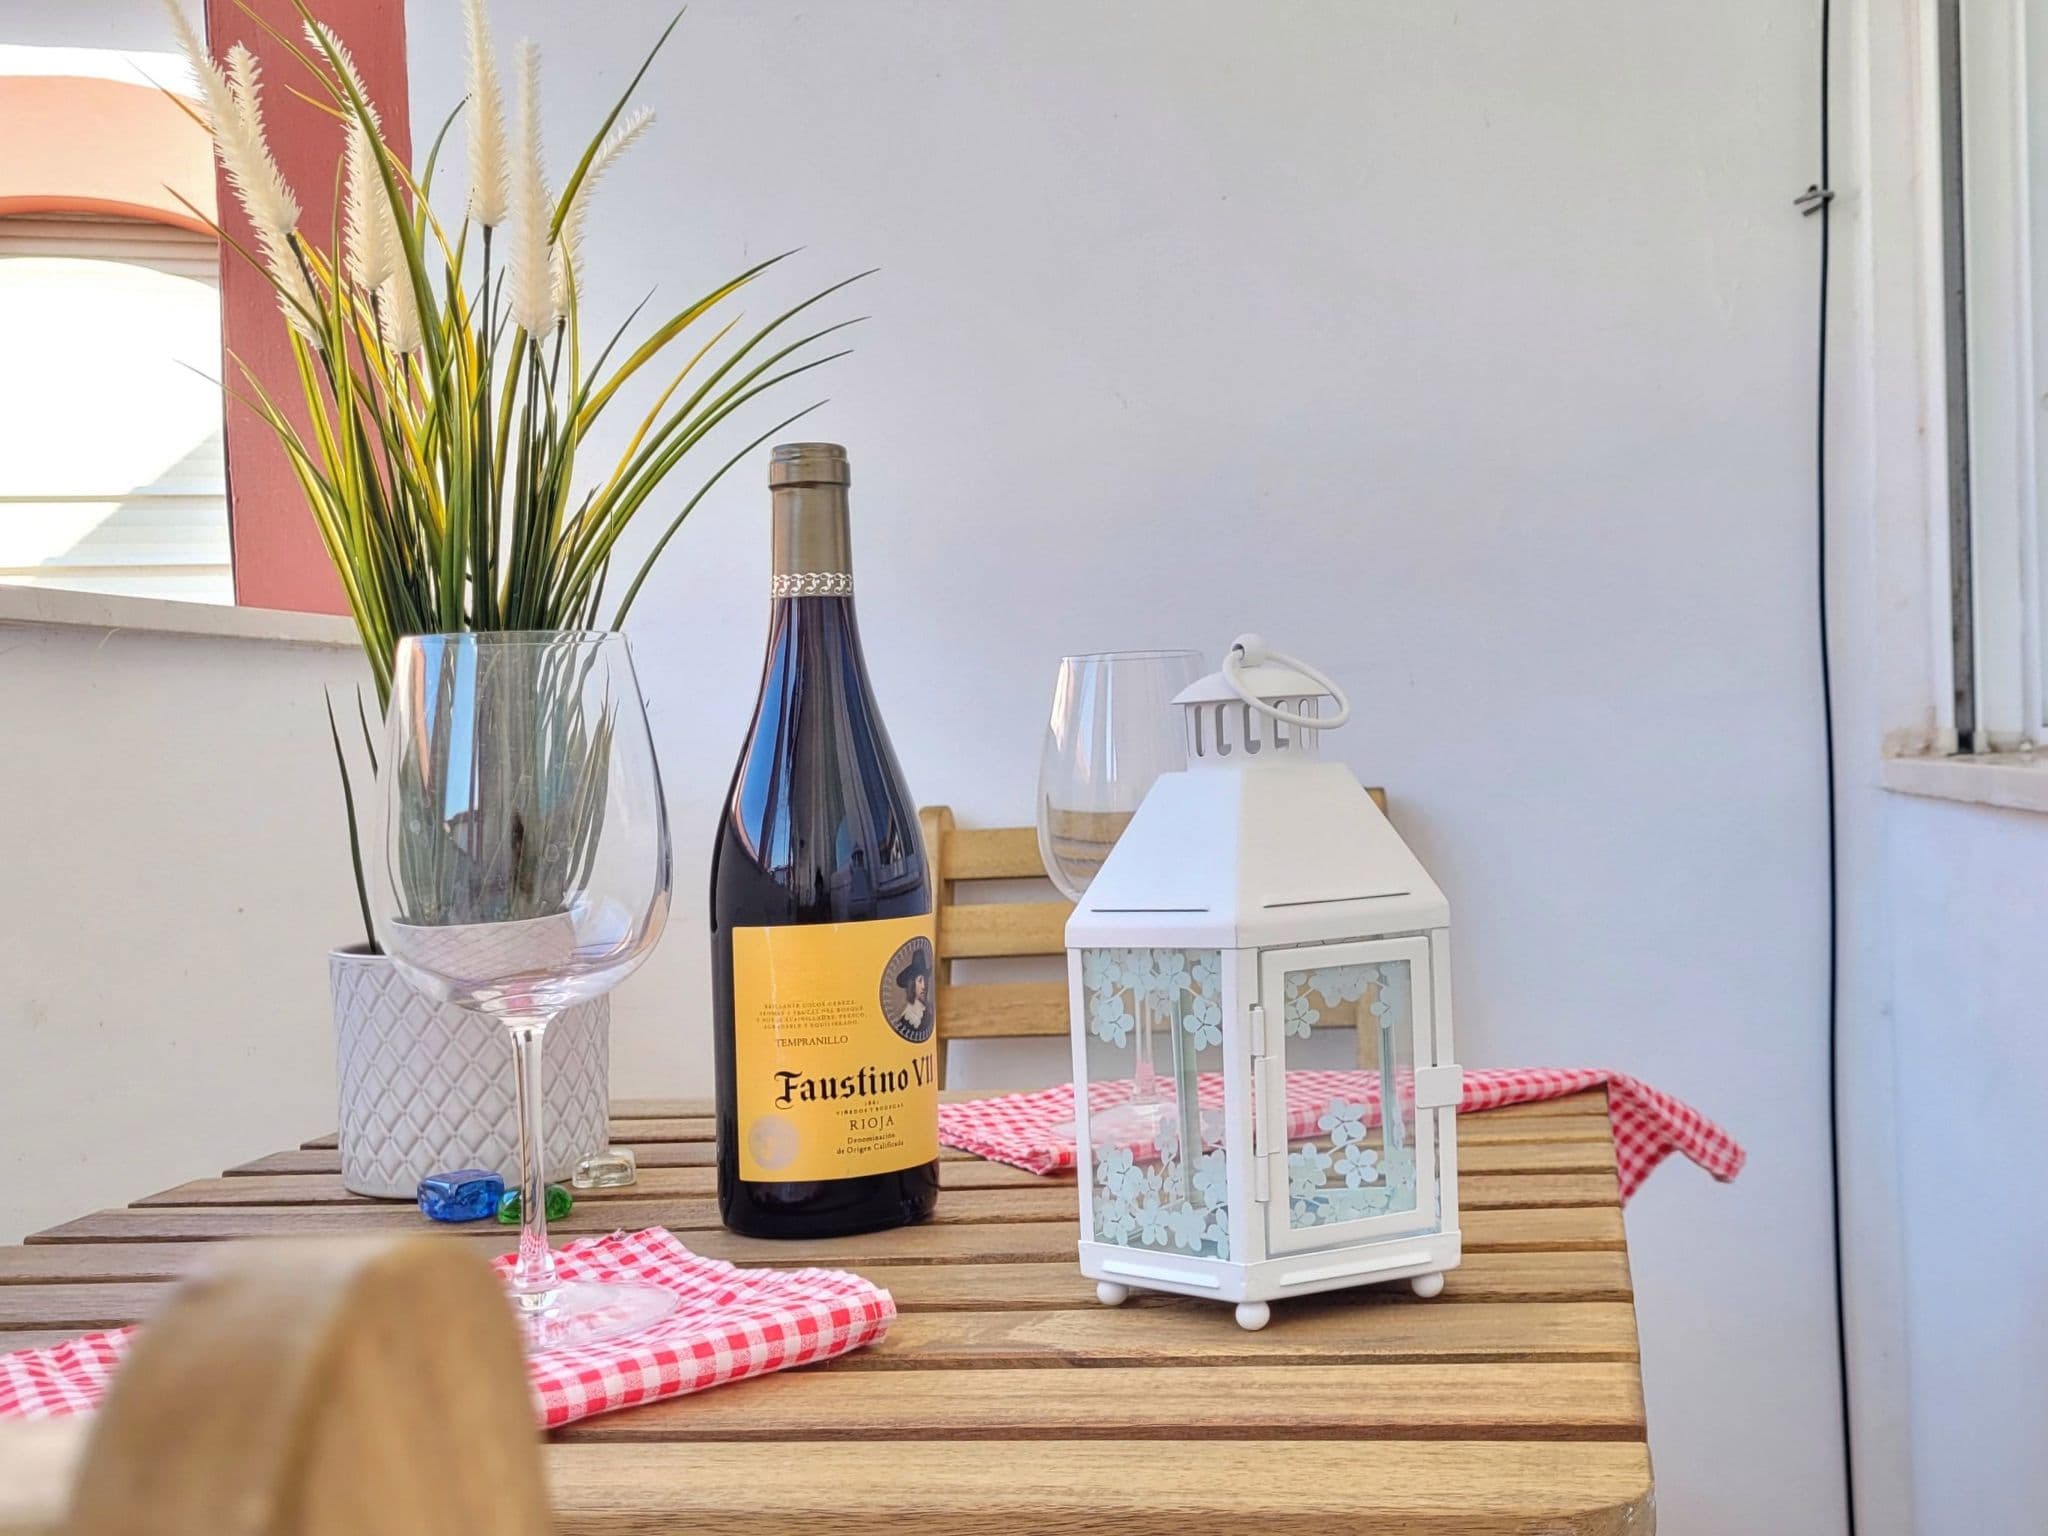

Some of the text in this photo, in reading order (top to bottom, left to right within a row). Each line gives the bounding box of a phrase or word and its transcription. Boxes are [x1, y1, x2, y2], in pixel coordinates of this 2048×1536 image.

[776, 1035, 849, 1047] TEMPRANILLO
[774, 1054, 933, 1110] Faustino VII
[849, 1115, 894, 1131] RIOJA
[847, 1145, 871, 1154] Origen
[873, 1139, 904, 1150] Calificada
